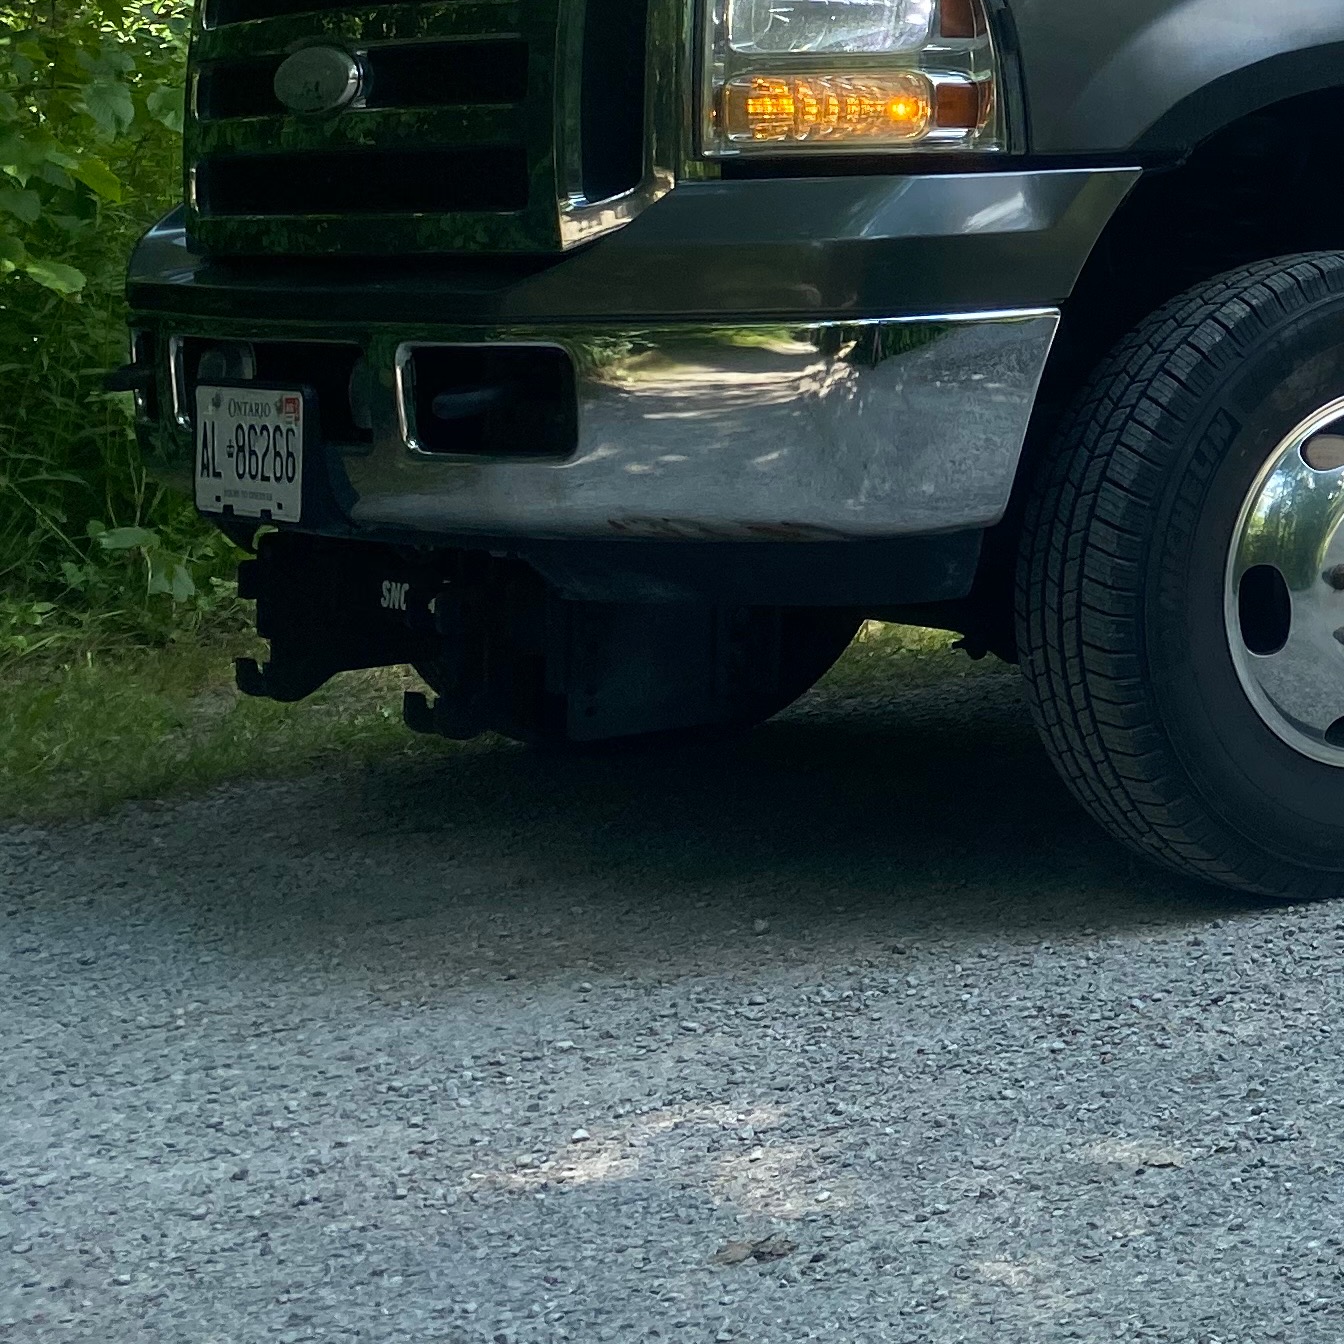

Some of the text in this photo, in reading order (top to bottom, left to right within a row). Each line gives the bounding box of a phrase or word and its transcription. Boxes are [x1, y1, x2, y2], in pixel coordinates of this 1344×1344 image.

[227, 397, 272, 418] ONTARIO
[200, 420, 297, 484] AL 86266
